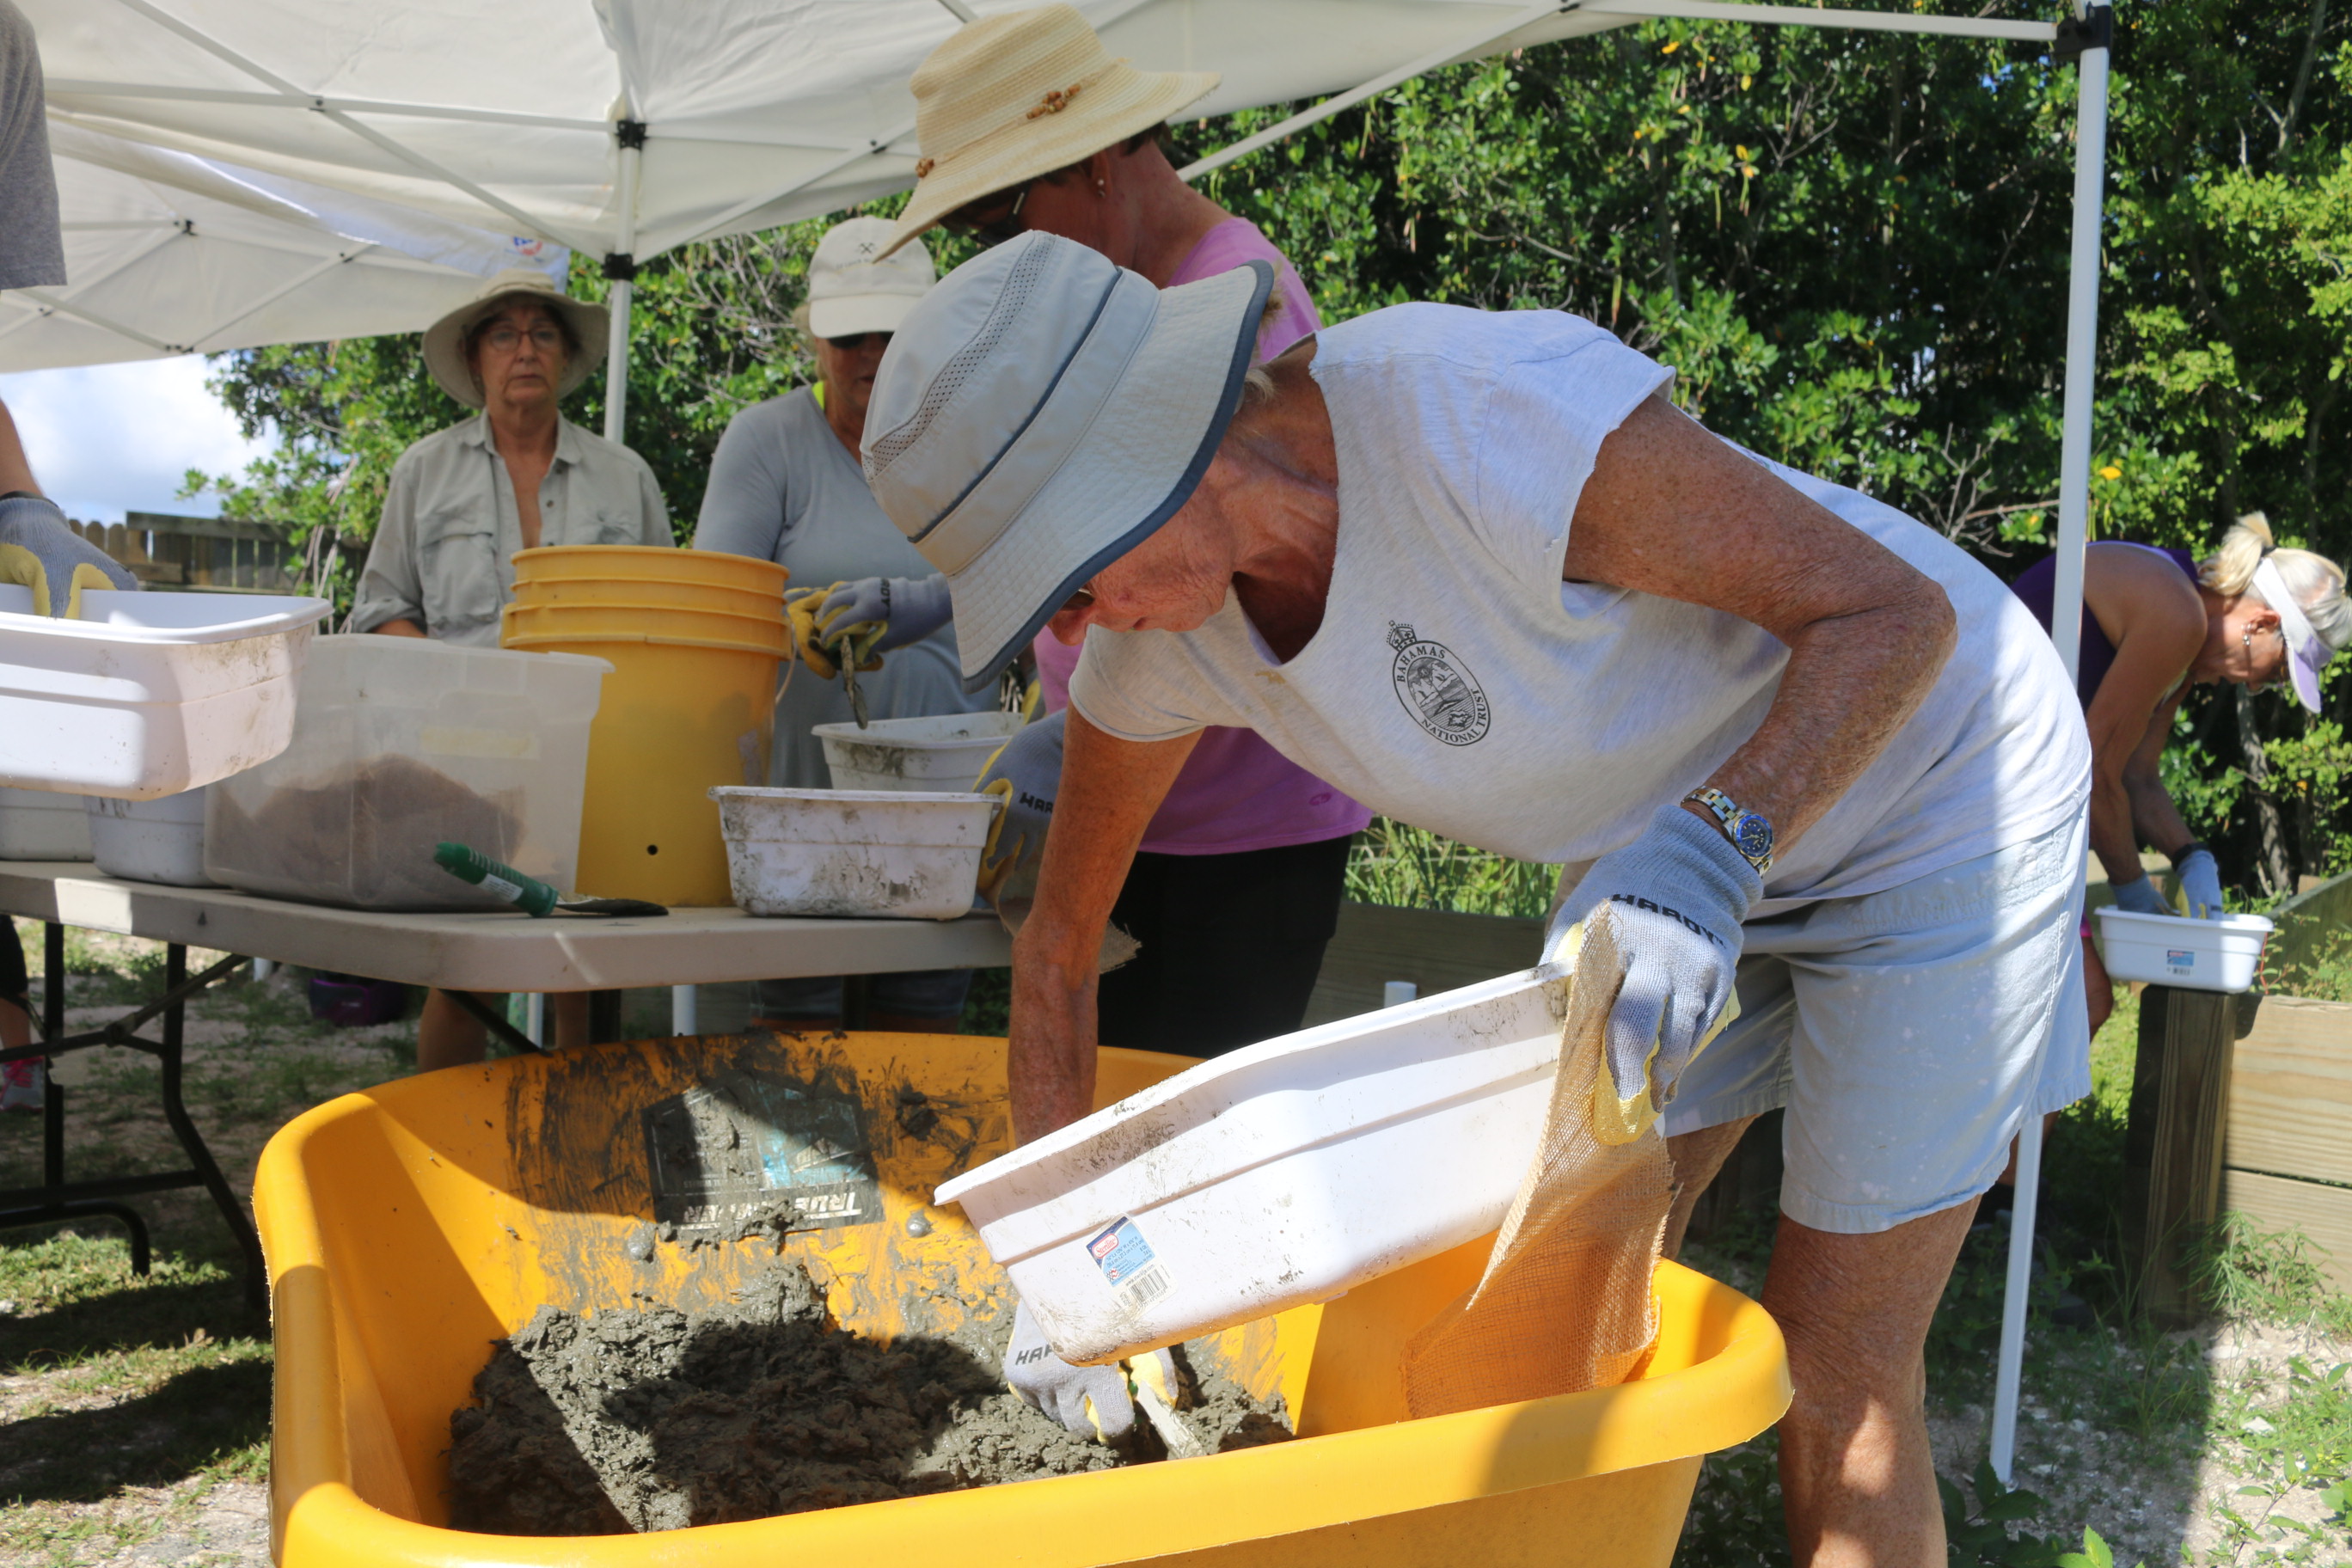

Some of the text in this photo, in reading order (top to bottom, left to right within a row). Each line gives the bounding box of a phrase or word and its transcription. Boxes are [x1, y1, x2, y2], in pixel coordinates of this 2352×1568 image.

[1397, 646, 1447, 683] BAHAMAS
[1422, 688, 1487, 744] NATIONAL TRUST
[794, 1191, 862, 1219] TRUE
